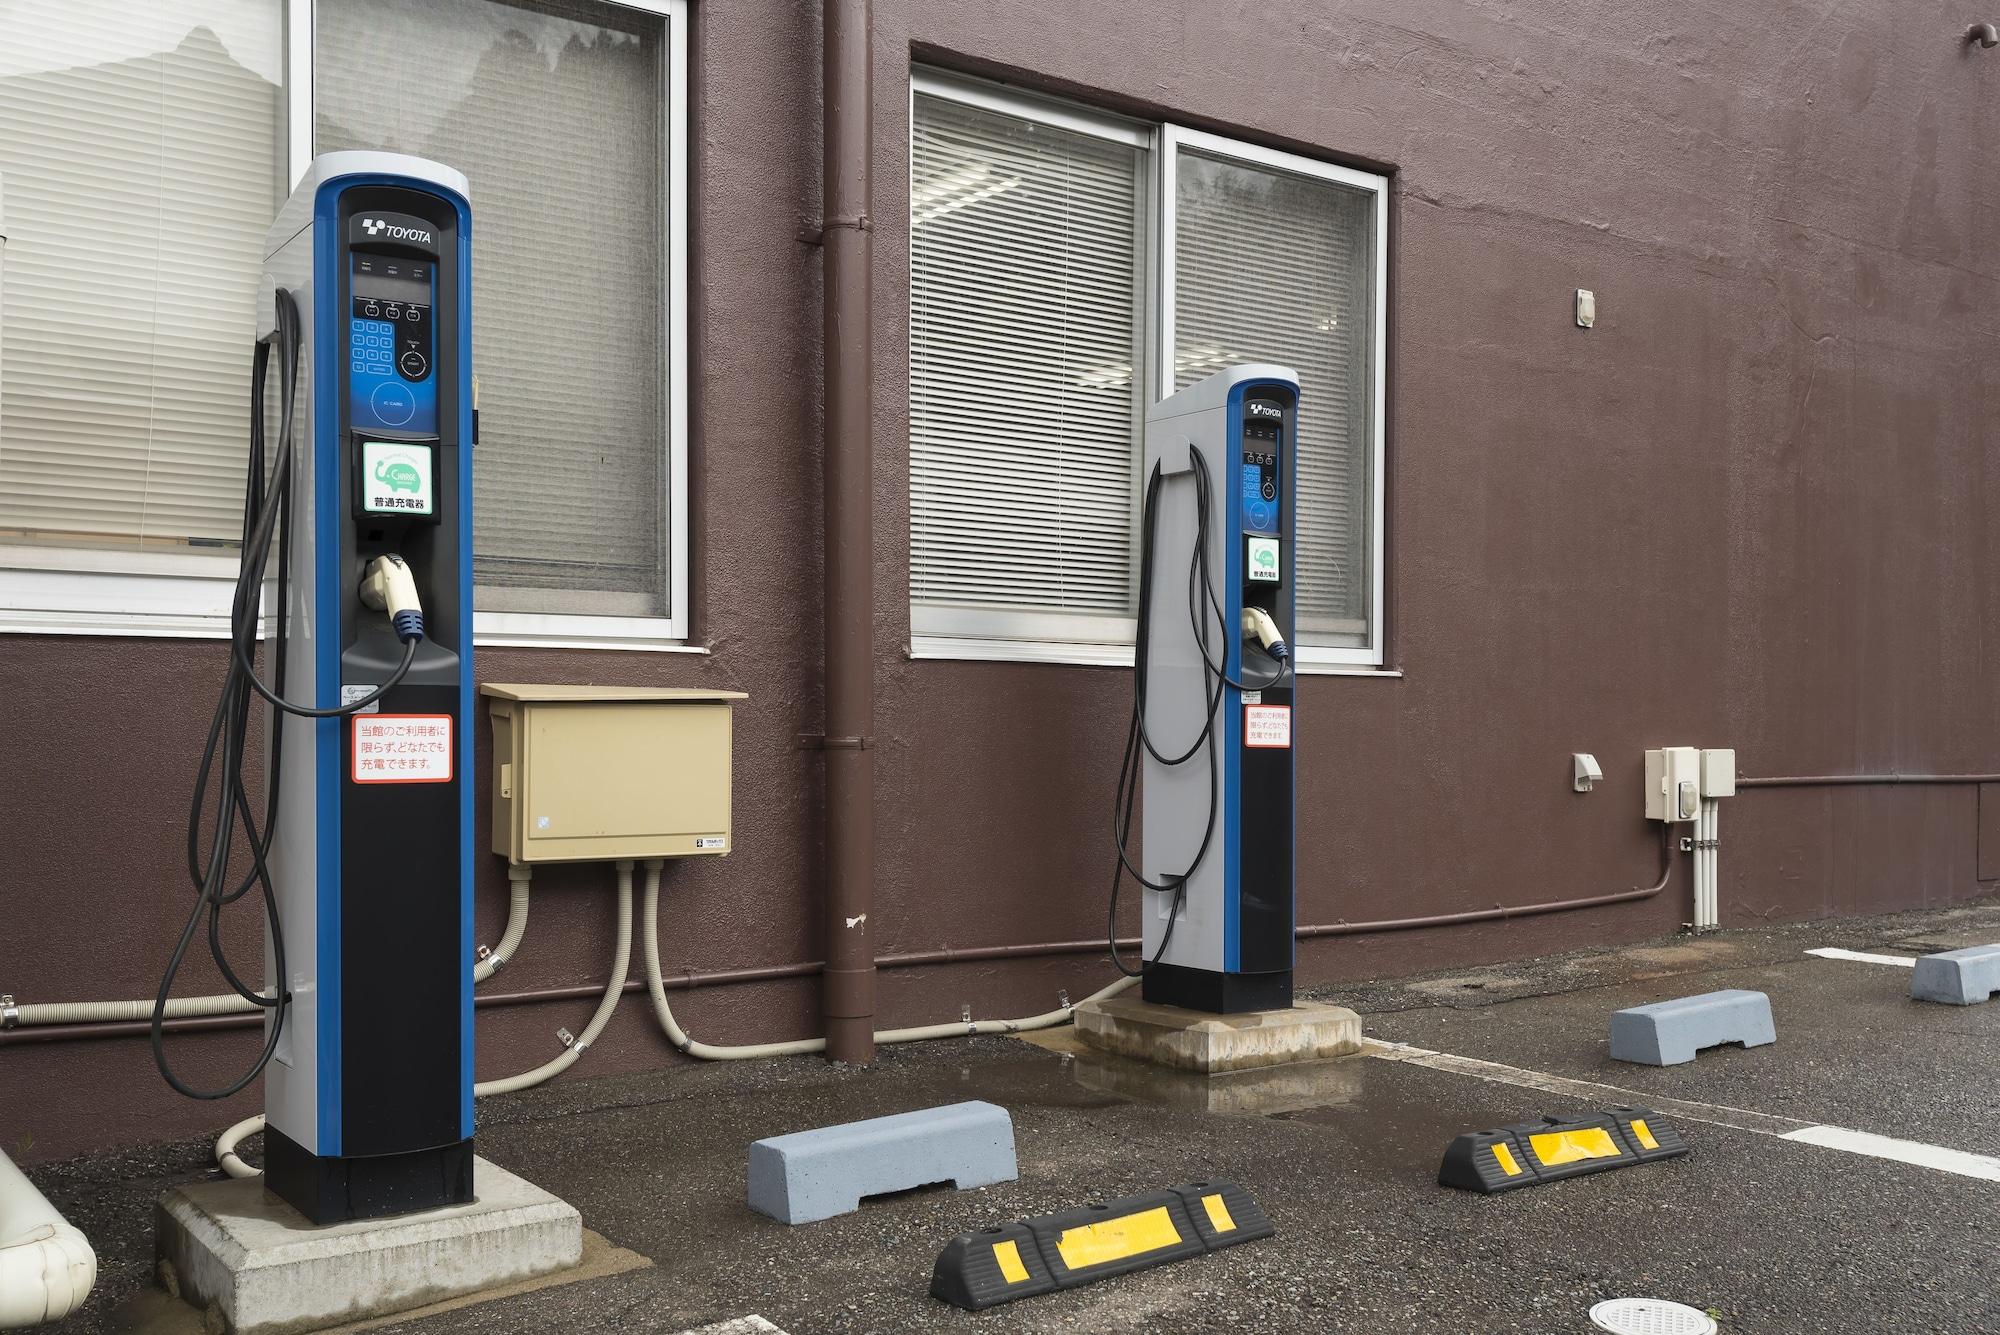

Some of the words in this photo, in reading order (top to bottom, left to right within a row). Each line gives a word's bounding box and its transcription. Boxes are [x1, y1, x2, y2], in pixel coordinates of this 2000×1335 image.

[386, 225, 431, 243] TOYOTA
[1262, 407, 1282, 418] TOYOTA
[374, 497, 424, 509] 普通充電器
[361, 725, 446, 737] 当館のご利用者に
[361, 758, 431, 770] 充電できます。
